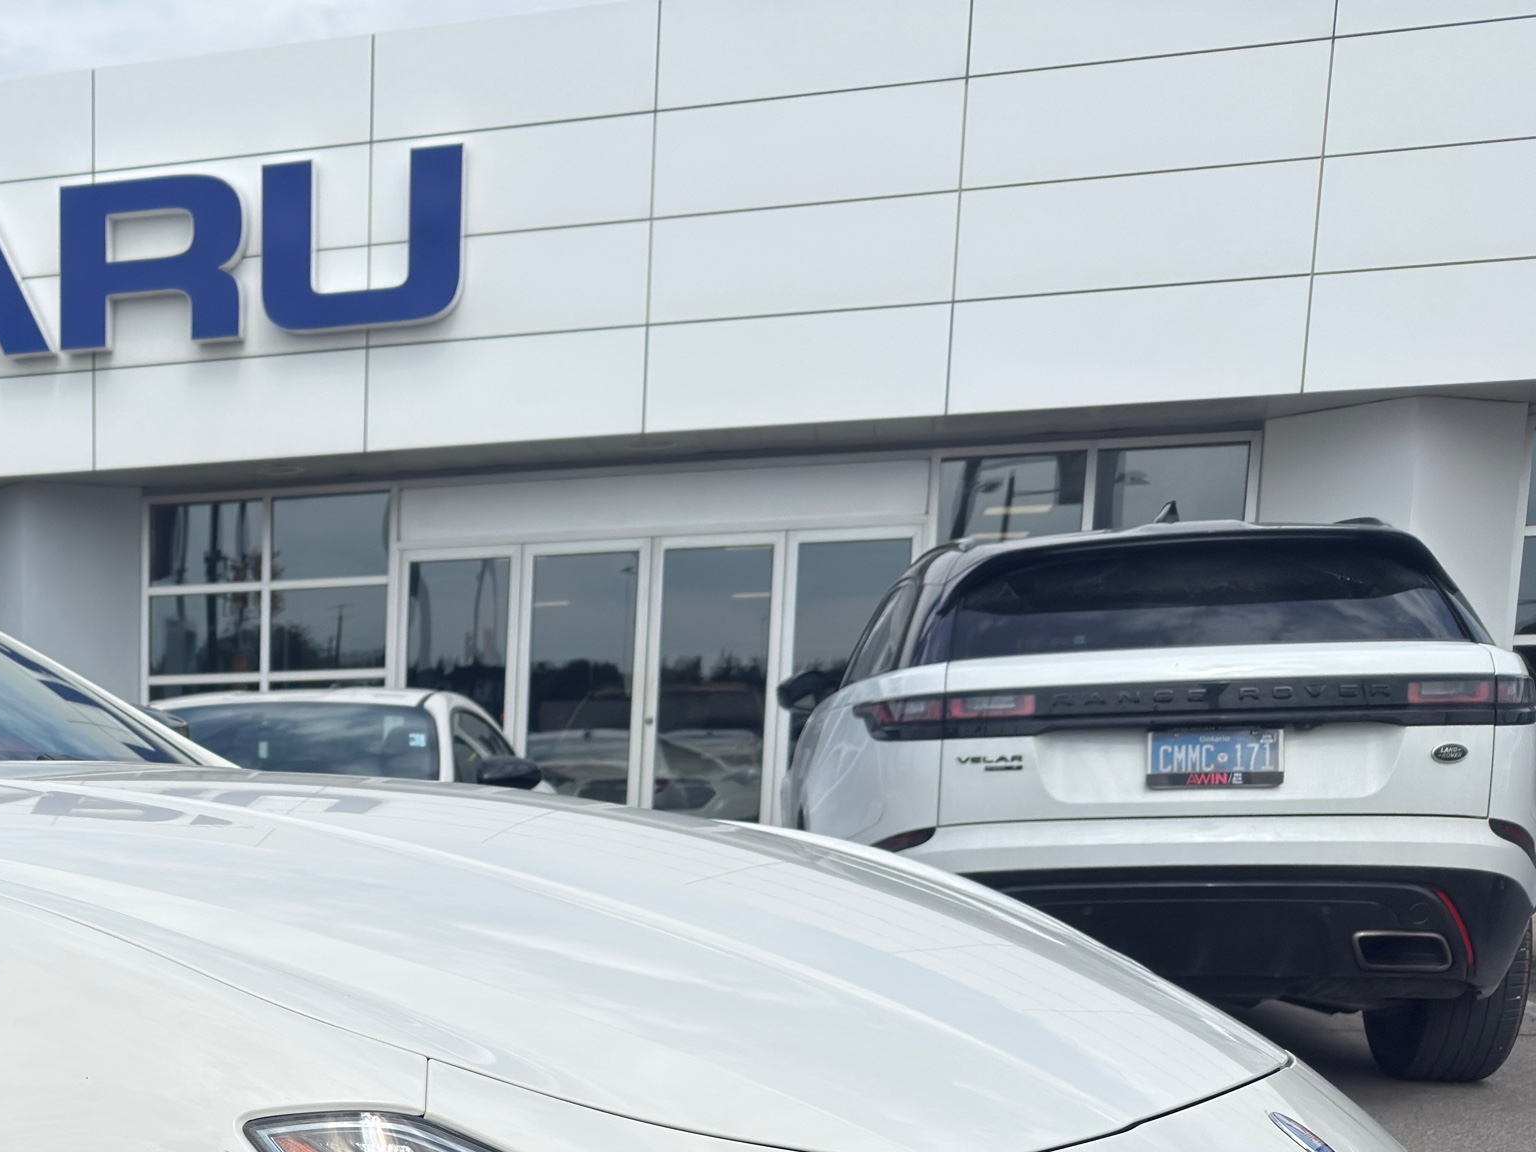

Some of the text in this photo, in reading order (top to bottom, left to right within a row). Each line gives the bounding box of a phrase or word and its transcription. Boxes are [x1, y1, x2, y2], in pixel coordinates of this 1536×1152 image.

[1051, 683, 1391, 707] RANGE ROVER
[1199, 735, 1231, 743] Ontario
[957, 755, 1023, 764] VELAR
[1159, 743, 1274, 772] CMMC 171
